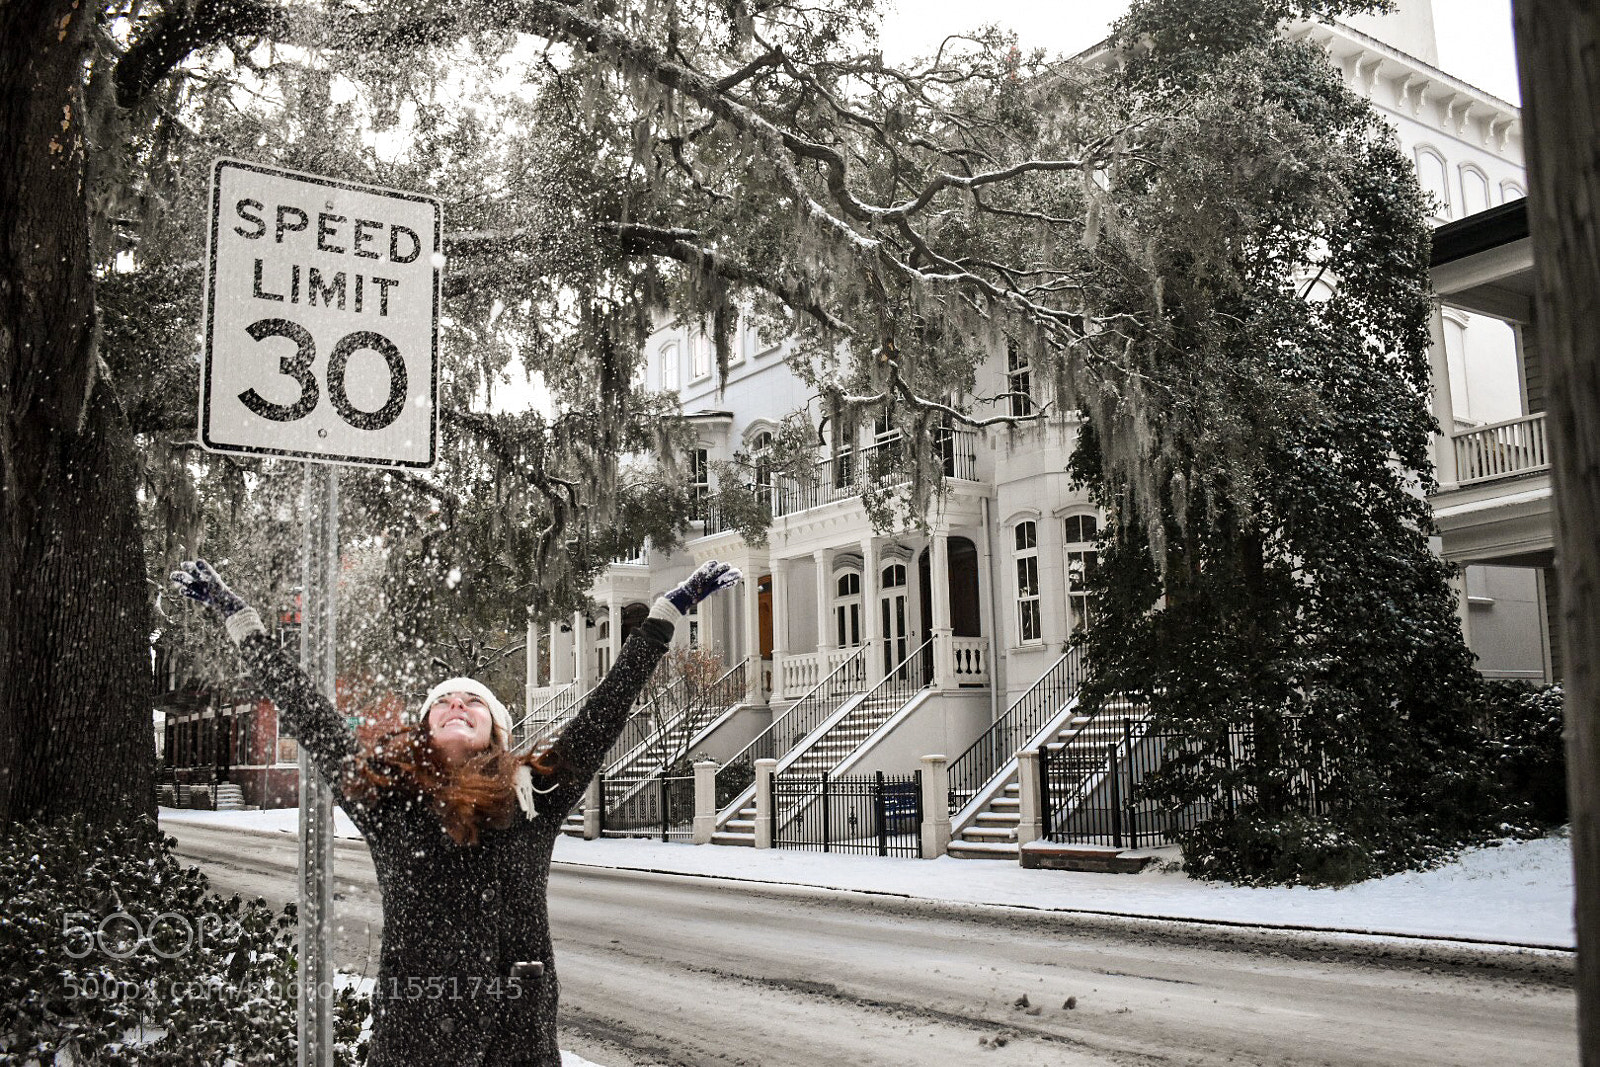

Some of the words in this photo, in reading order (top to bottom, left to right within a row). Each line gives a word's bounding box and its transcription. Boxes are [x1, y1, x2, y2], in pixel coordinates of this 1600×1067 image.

[233, 198, 421, 264] SPEED
[253, 258, 399, 317] LIMIT
[237, 318, 408, 431] 30
